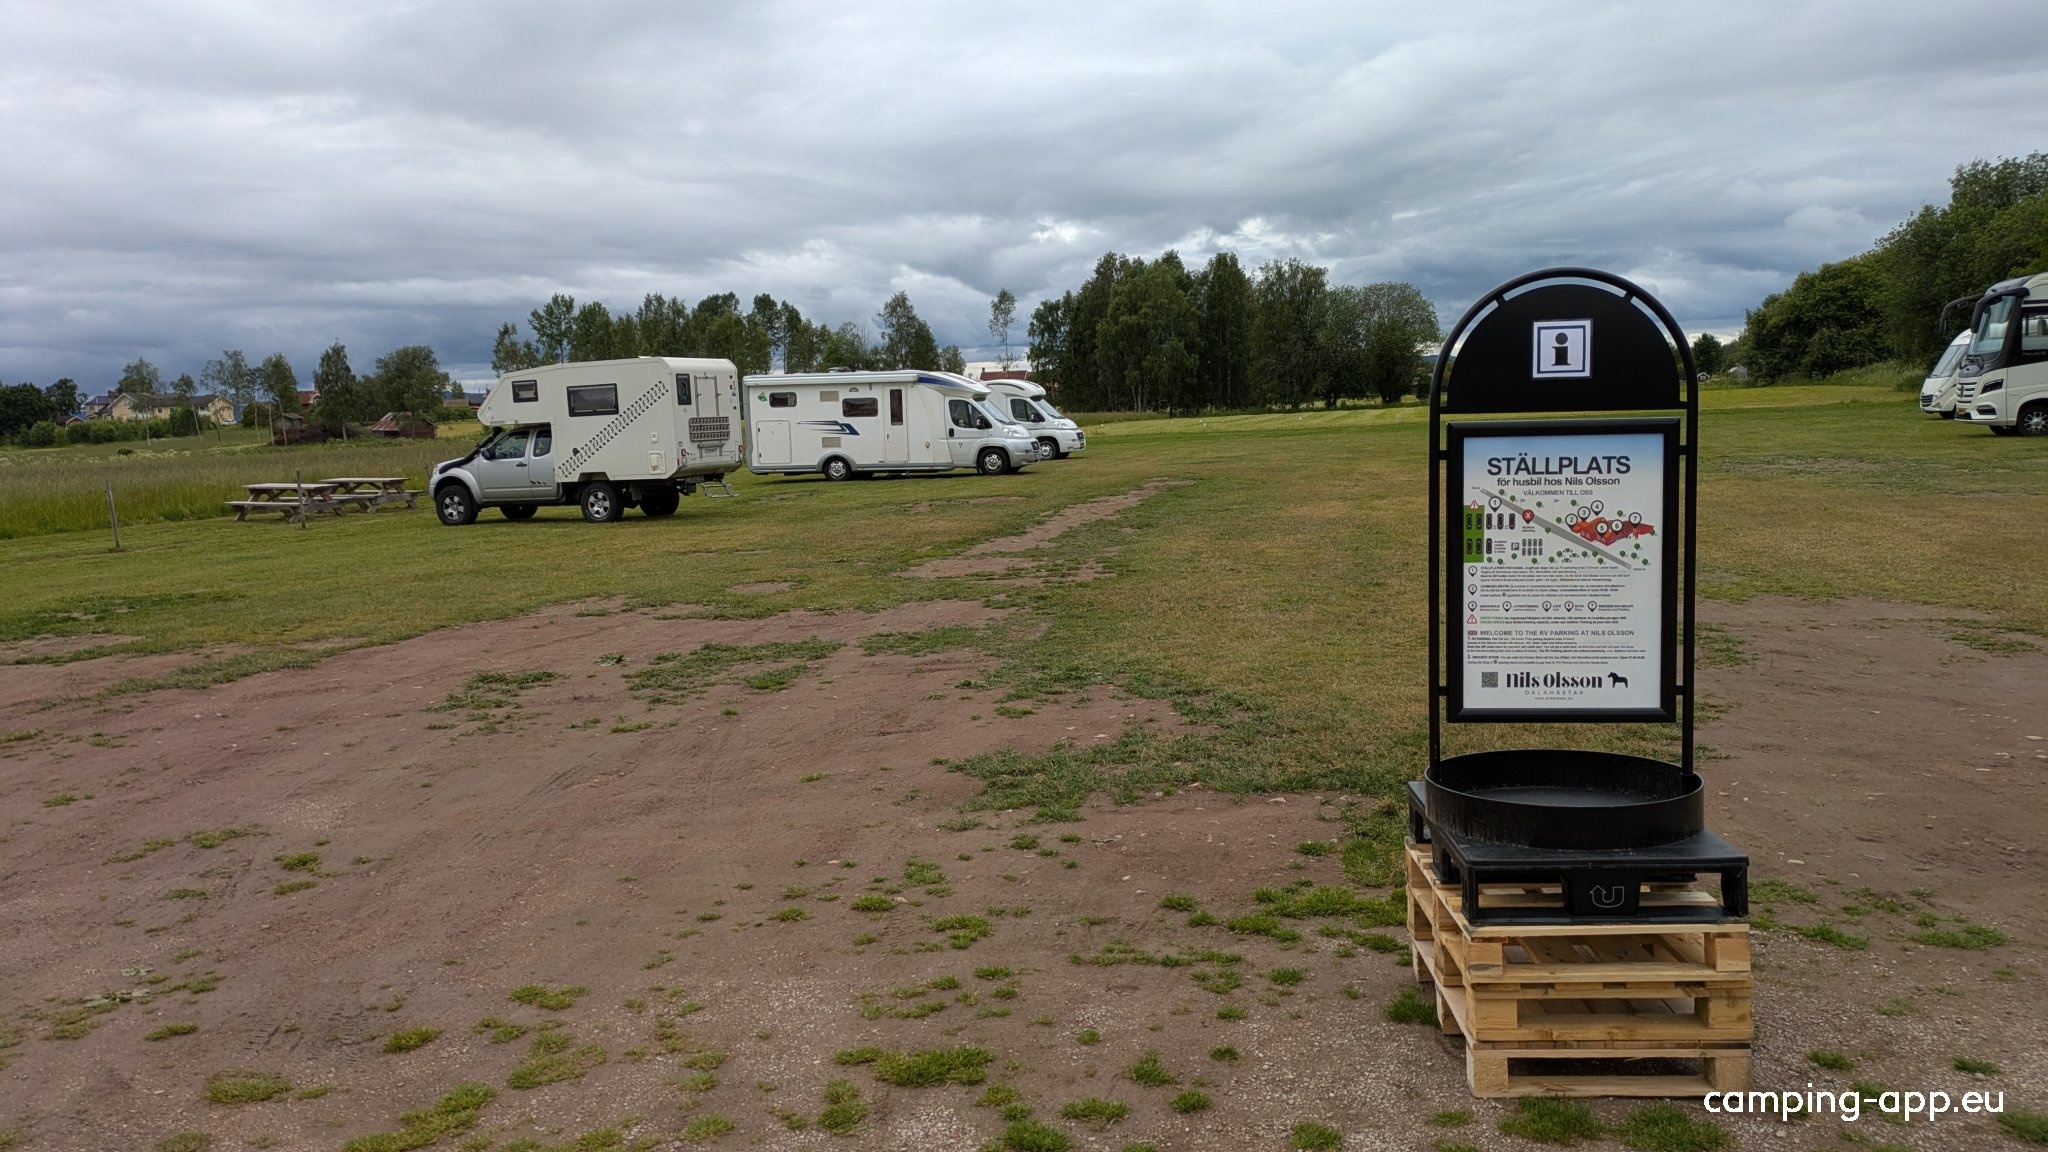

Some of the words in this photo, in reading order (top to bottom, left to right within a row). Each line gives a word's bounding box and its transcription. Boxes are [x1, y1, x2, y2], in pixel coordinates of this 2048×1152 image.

[1551, 332, 1572, 366] i
[1487, 452, 1631, 476] STÄLLPLATS
[1497, 477, 1510, 486] för
[1513, 477, 1542, 486] husbil
[1544, 477, 1562, 486] hos
[1565, 476, 1583, 486] Nils
[1585, 476, 1620, 486] Olsson
[1543, 672, 1602, 688] Olsson
